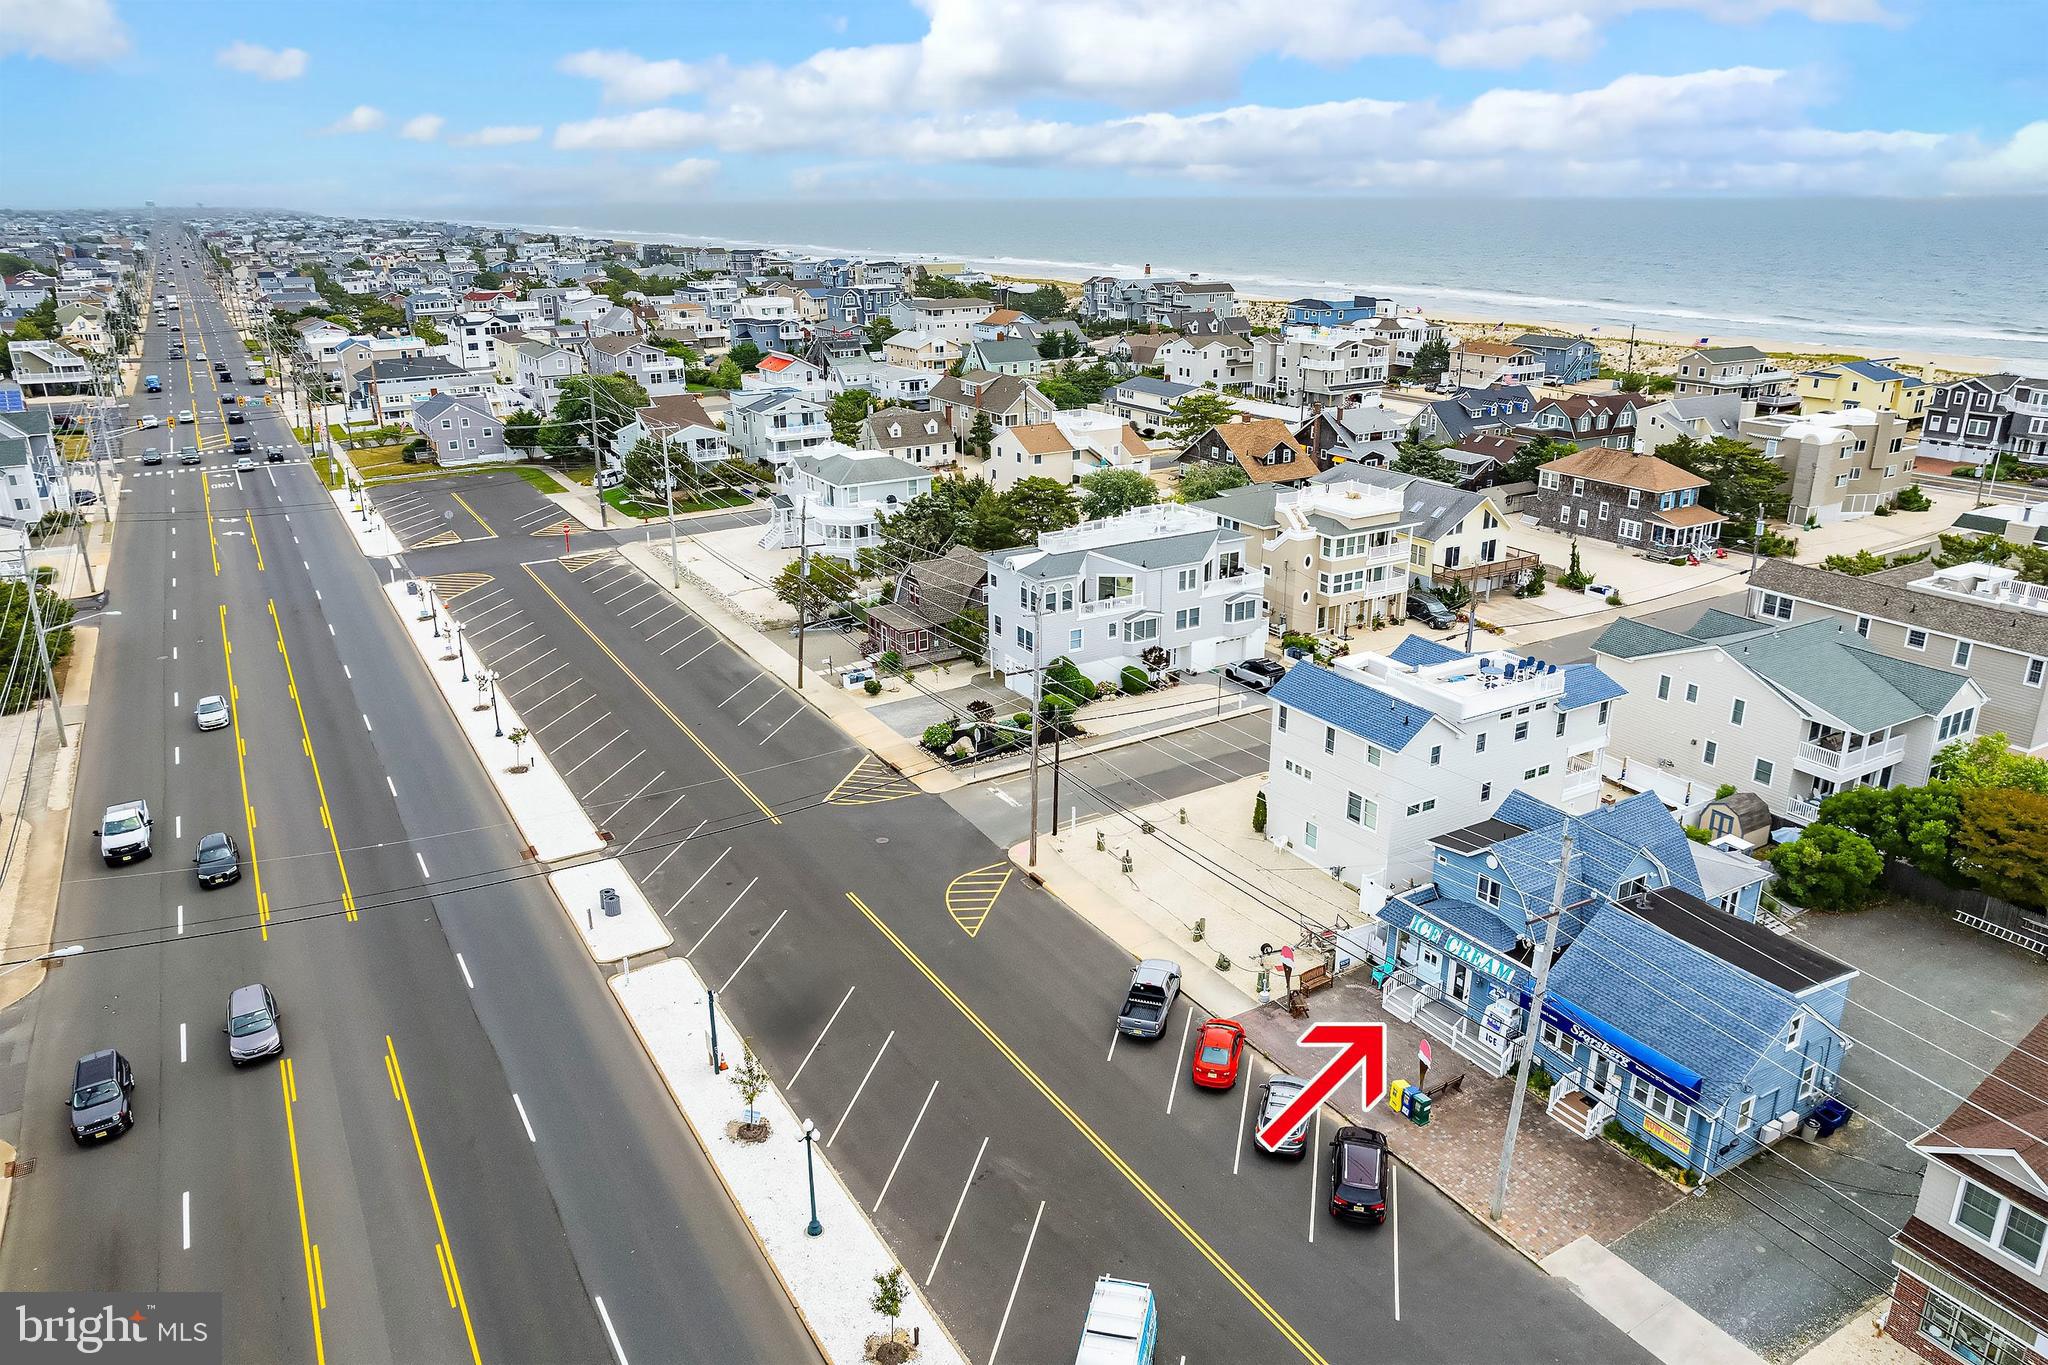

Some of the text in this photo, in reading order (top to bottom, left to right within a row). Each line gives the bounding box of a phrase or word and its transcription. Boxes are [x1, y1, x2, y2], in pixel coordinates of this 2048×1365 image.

[211, 481, 234, 489] ONLY
[1409, 914, 1516, 985] ICE CREAM
[1485, 1032, 1498, 1047] ICE
